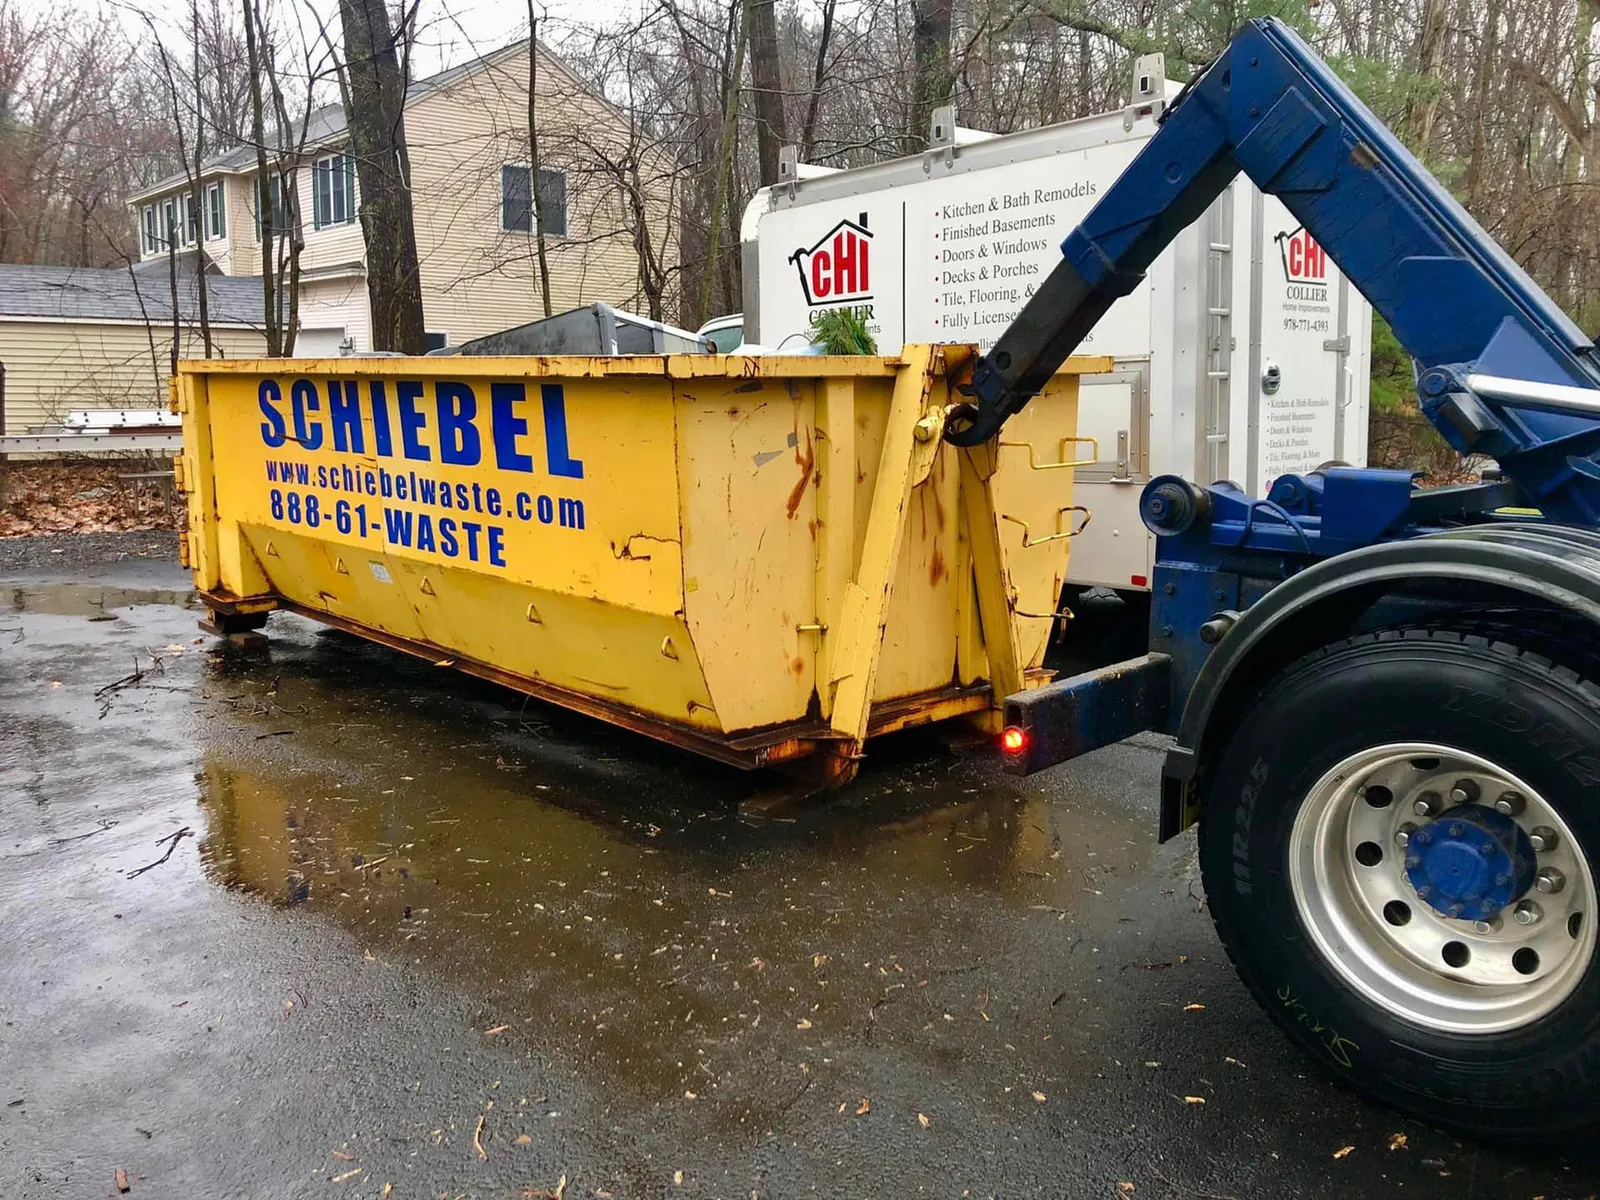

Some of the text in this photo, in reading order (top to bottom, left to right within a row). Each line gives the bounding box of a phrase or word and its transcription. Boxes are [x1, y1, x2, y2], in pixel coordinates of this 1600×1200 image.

[942, 180, 1096, 219] Kitchen & Bath Remodels
[942, 212, 1056, 241] Finished Basements
[942, 238, 1048, 263] Doors & Windows
[812, 231, 869, 298] CHI
[942, 261, 1039, 285] Decks & Porches
[942, 282, 1035, 307] Tile, Flooring, &
[1287, 286, 1327, 301] COLLIER
[942, 312, 970, 330] Fully
[1284, 319, 1328, 332] 978-771-4393
[258, 379, 584, 479] SCHIEBEL
[265, 459, 586, 530] www.schiebelwaste.com
[270, 489, 507, 568] 888-61-WASTE
